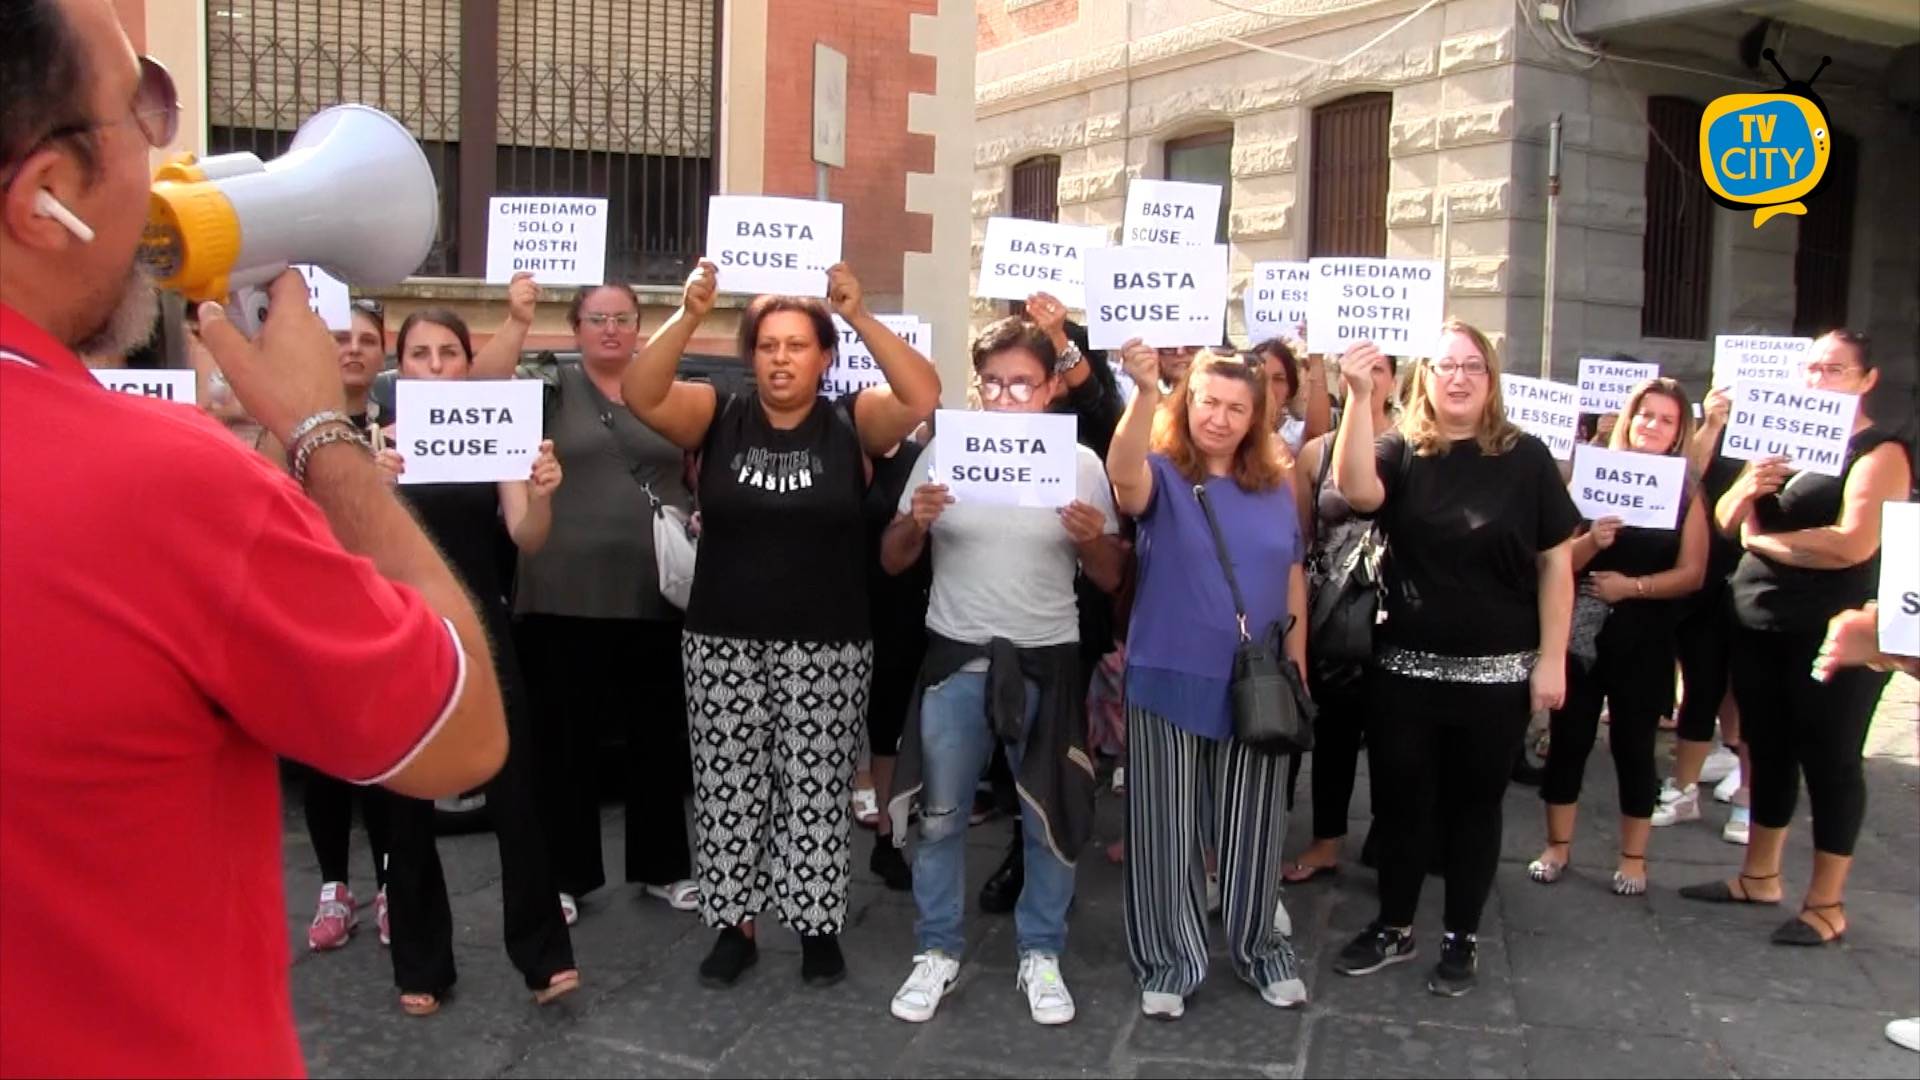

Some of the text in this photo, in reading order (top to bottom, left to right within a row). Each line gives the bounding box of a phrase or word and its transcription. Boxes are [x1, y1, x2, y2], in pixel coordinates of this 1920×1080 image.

[500, 203, 597, 216] CHIEDIAMO
[1142, 202, 1195, 220] BASTA
[518, 221, 575, 234] SOLO I
[736, 221, 814, 241] BASTA
[1131, 227, 1181, 245] SCUSE
[513, 240, 577, 252] NOSTRI
[1010, 239, 1078, 259] BASTA
[513, 258, 576, 271] DIRITTI
[720, 250, 798, 269] SCUSE
[994, 263, 1063, 282] SCUSE
[1113, 272, 1195, 290] BASTA
[1320, 264, 1431, 281] CHIEDIAMO
[1259, 289, 1274, 300] DI
[1343, 284, 1407, 300] SOLO I
[1100, 305, 1180, 322] SCUSE
[1256, 310, 1282, 322] GLI
[1338, 305, 1410, 321] NOSTRI
[1338, 325, 1408, 341] DIRITTI
[1725, 339, 1805, 351] CHIEDIAMO
[1741, 353, 1778, 364] SOLO
[1588, 365, 1648, 378] STANCHI
[1737, 368, 1789, 378] NOSTRI
[1509, 383, 1573, 405] STANCHI
[1582, 381, 1594, 390] DI
[1580, 397, 1600, 407] GLI
[1748, 389, 1841, 415] STANCHI
[430, 408, 513, 424] BASTA
[1521, 408, 1573, 428] ESSERE
[1736, 411, 1843, 440] DI ESSERE
[414, 439, 497, 456] SCUSE
[965, 437, 1046, 454] BASTA
[1728, 435, 1840, 466] GLI ULTIMI
[952, 465, 1031, 482] SCUSE
[1595, 467, 1658, 488] BASTA
[1582, 487, 1644, 508] SCUSE
